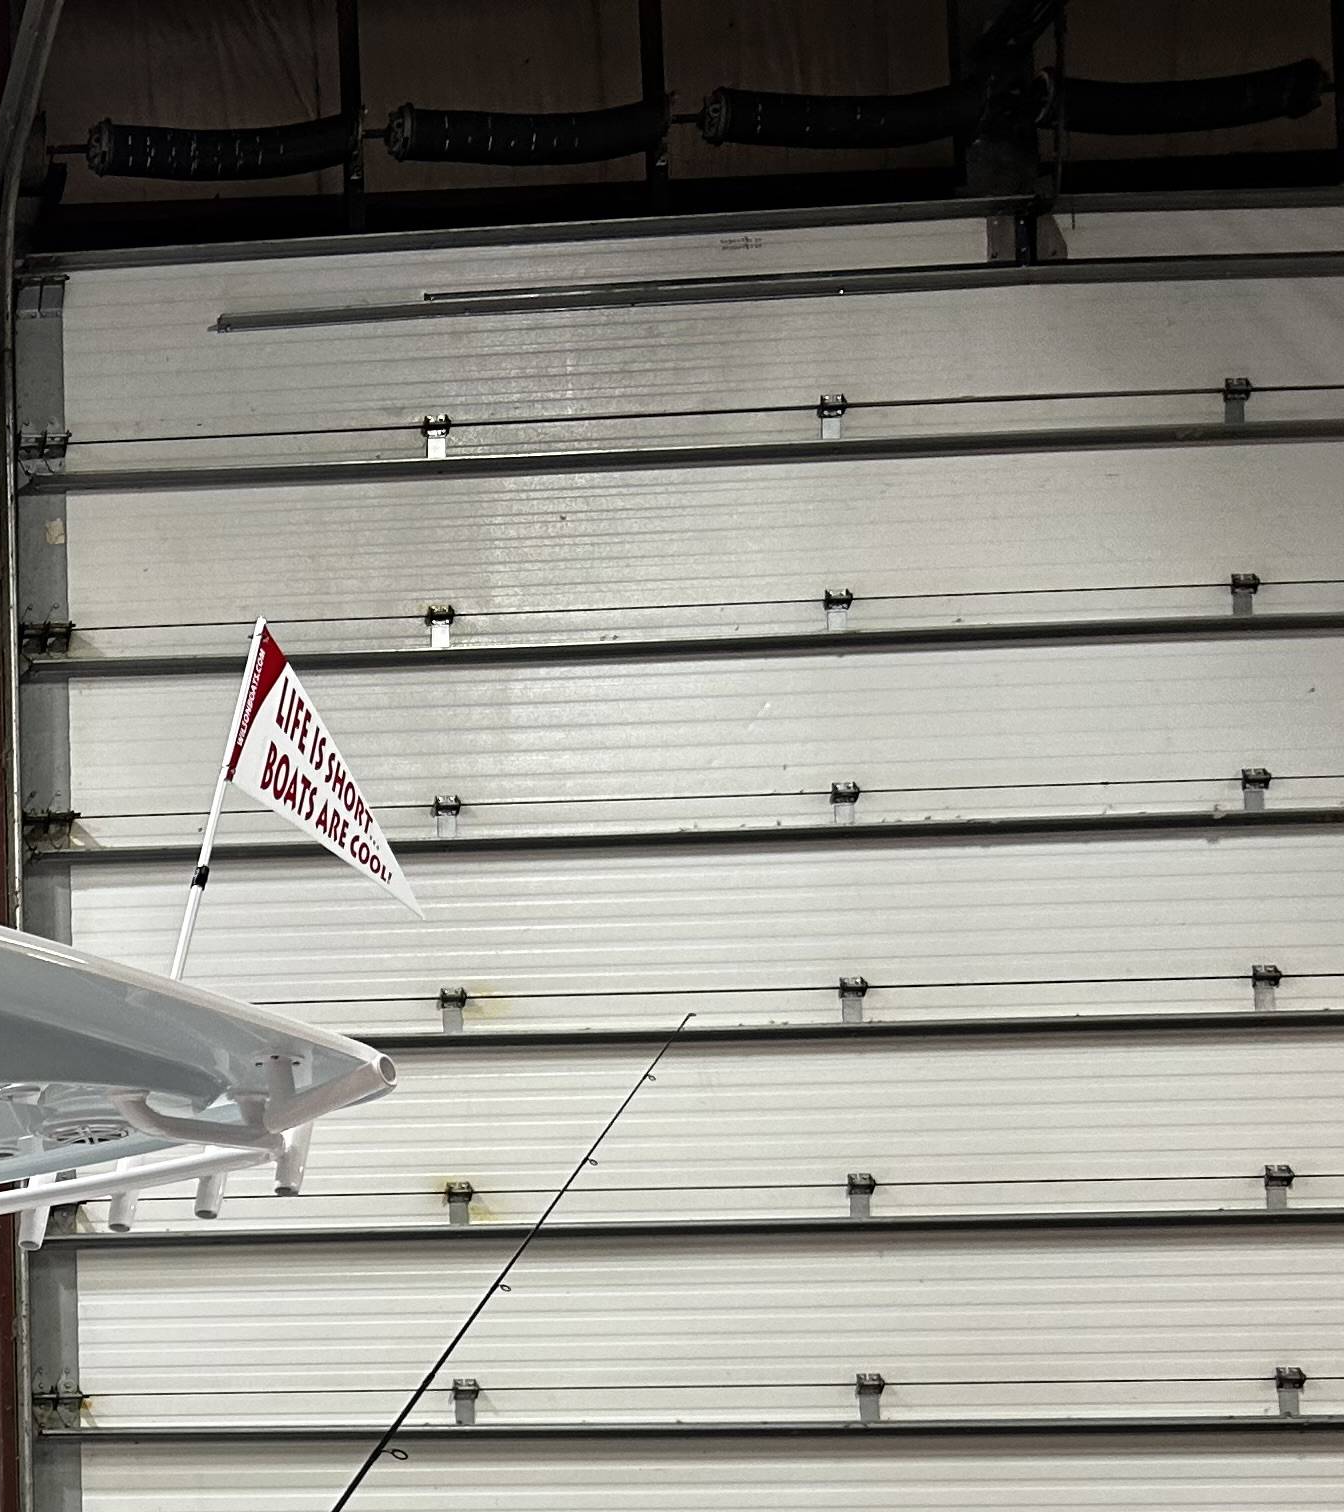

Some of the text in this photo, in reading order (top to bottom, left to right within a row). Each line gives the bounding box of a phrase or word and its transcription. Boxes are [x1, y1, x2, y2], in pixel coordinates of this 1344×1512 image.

[236, 647, 266, 747] WILSONBOATS.COM
[275, 676, 313, 754] LIFE
[309, 726, 327, 771] IS
[260, 740, 393, 885] BOATS ARE COOL!
